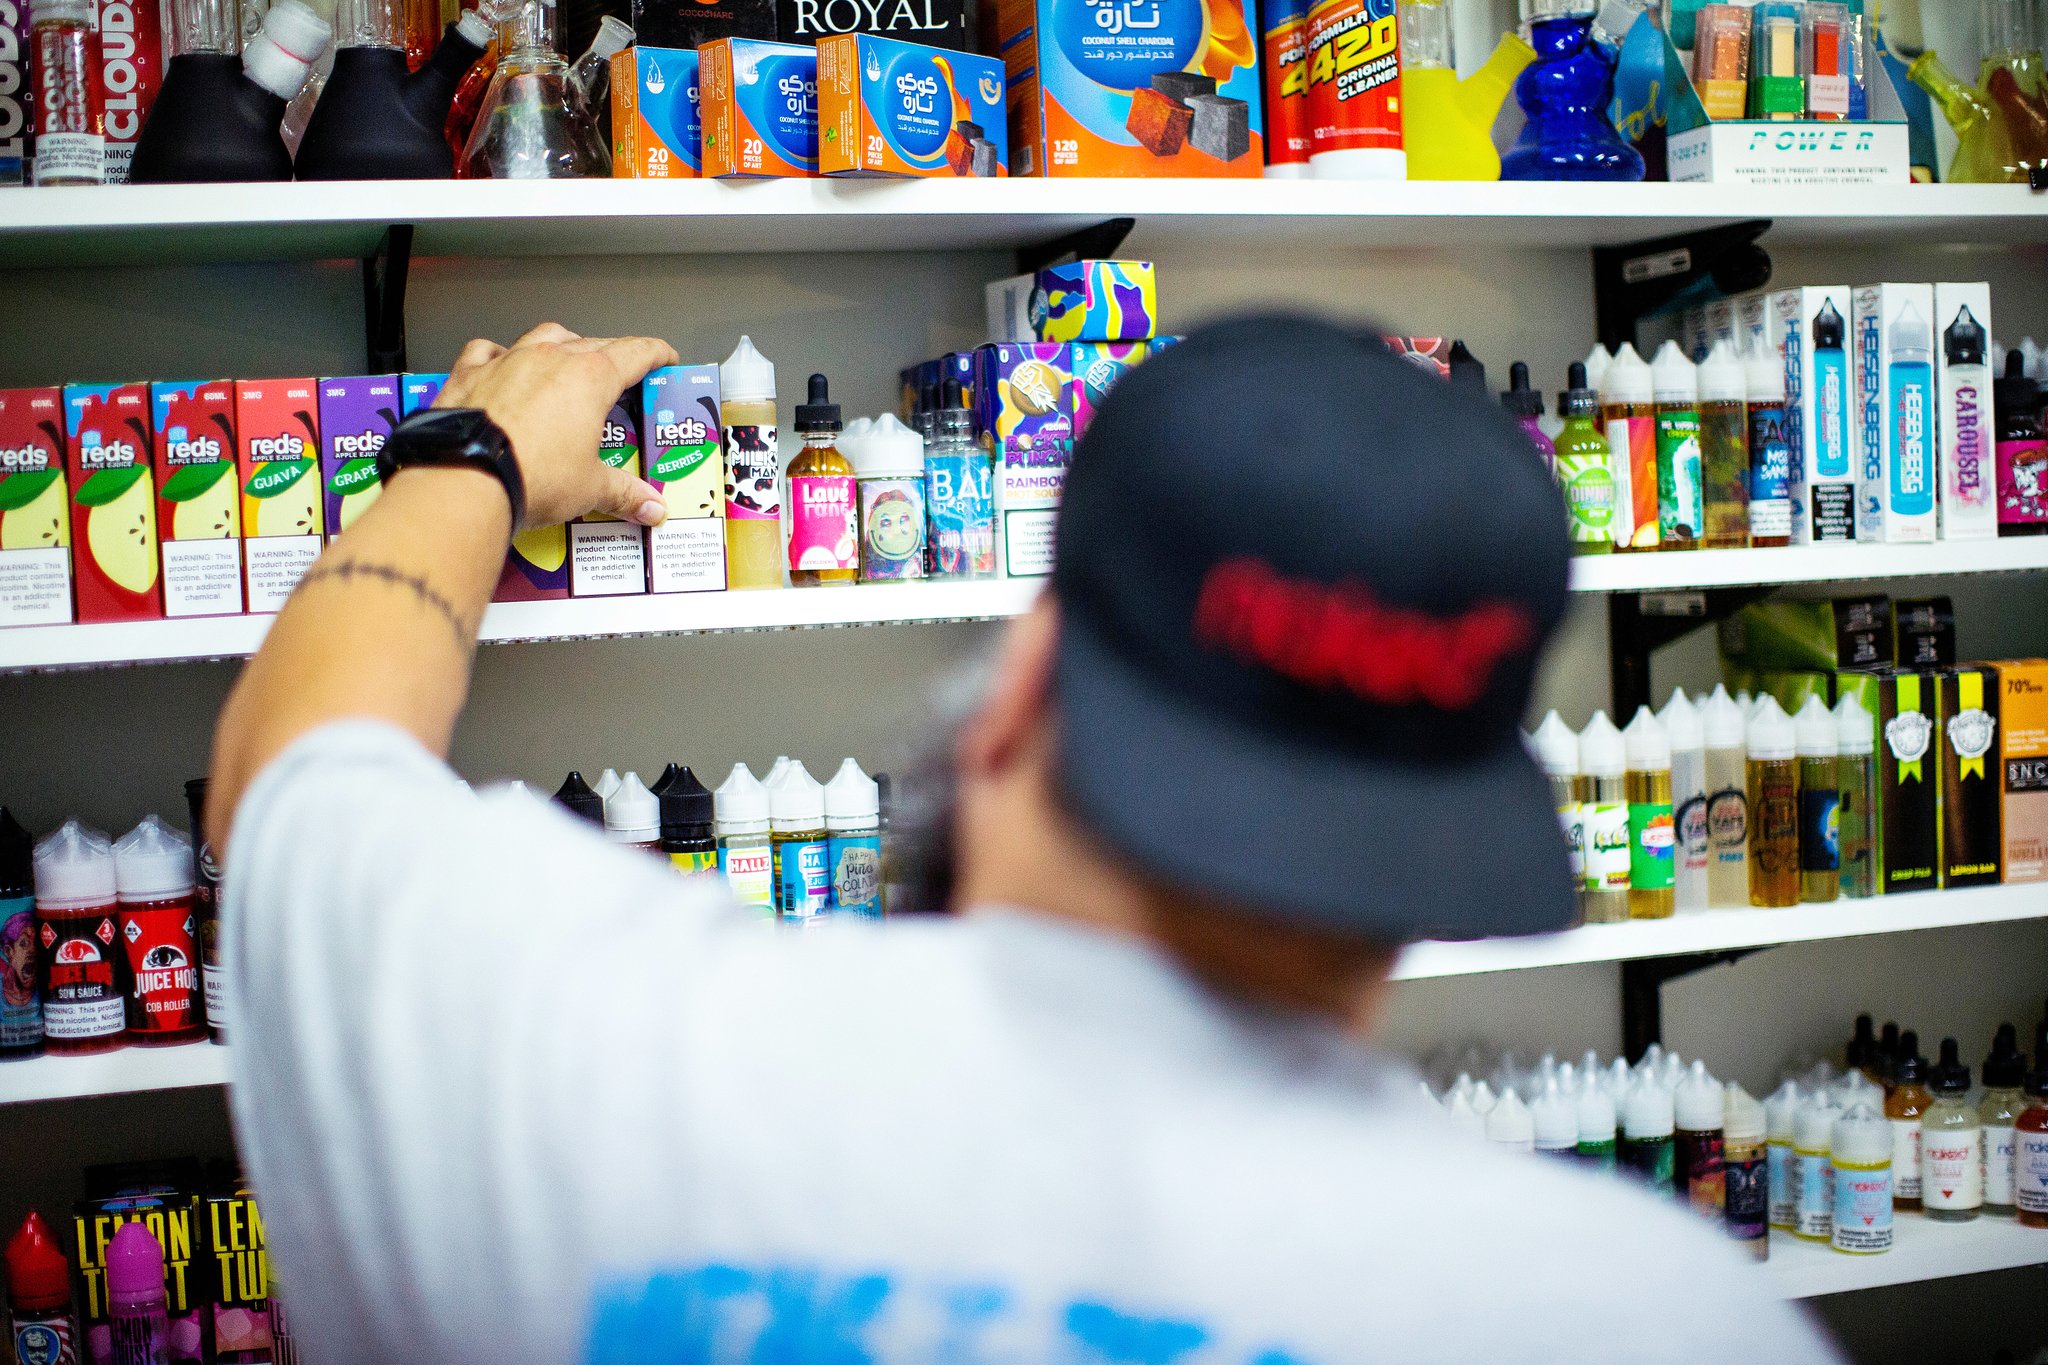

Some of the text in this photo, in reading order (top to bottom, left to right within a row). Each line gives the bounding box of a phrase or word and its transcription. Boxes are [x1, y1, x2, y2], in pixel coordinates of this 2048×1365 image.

[795, 0, 949, 33] ROYAL
[1308, 10, 1369, 54] FORMULA
[1082, 37, 1175, 46] COCONUT SHELL CHARCOAL
[1310, 14, 1398, 85] 420
[102, 0, 139, 140] CLOUD
[1337, 54, 1398, 88] ORIGINAL
[1337, 66, 1398, 101] CLEANER
[743, 139, 762, 155] 20
[868, 135, 883, 151] 20
[1054, 139, 1079, 151] 120
[1750, 131, 1875, 150] POWER
[105, 150, 132, 159] NING
[648, 147, 669, 163] 20
[1000, 349, 1010, 363] 0
[1074, 347, 1085, 361] 3
[691, 376, 713, 384] 60ML
[243, 390, 310, 399] 3MG 60ML
[326, 387, 392, 397] 3MG 60ML
[409, 385, 427, 394] 3MG
[656, 418, 706, 440] reds
[168, 436, 220, 458] reds
[251, 433, 304, 455] reds
[334, 430, 385, 452] reds
[1955, 386, 1980, 494] CAROUSEL
[81, 440, 135, 463] reds
[657, 450, 703, 474] BERRIES
[254, 466, 301, 490] GUAVA
[578, 534, 637, 543] WARNING: This
[658, 532, 698, 540] WARNING:
[576, 544, 640, 554] product contains
[656, 543, 686, 551] product
[252, 561, 283, 569] product
[576, 555, 608, 563] nicotine.
[601, 563, 636, 571] addictive
[731, 855, 770, 874] HALLZ
[134, 970, 172, 999] JUICE
[175, 967, 197, 991] HOG
[59, 985, 102, 998] SOW SAUCE
[146, 999, 190, 1013] COB ROLLER
[77, 1209, 192, 1269] LEON
